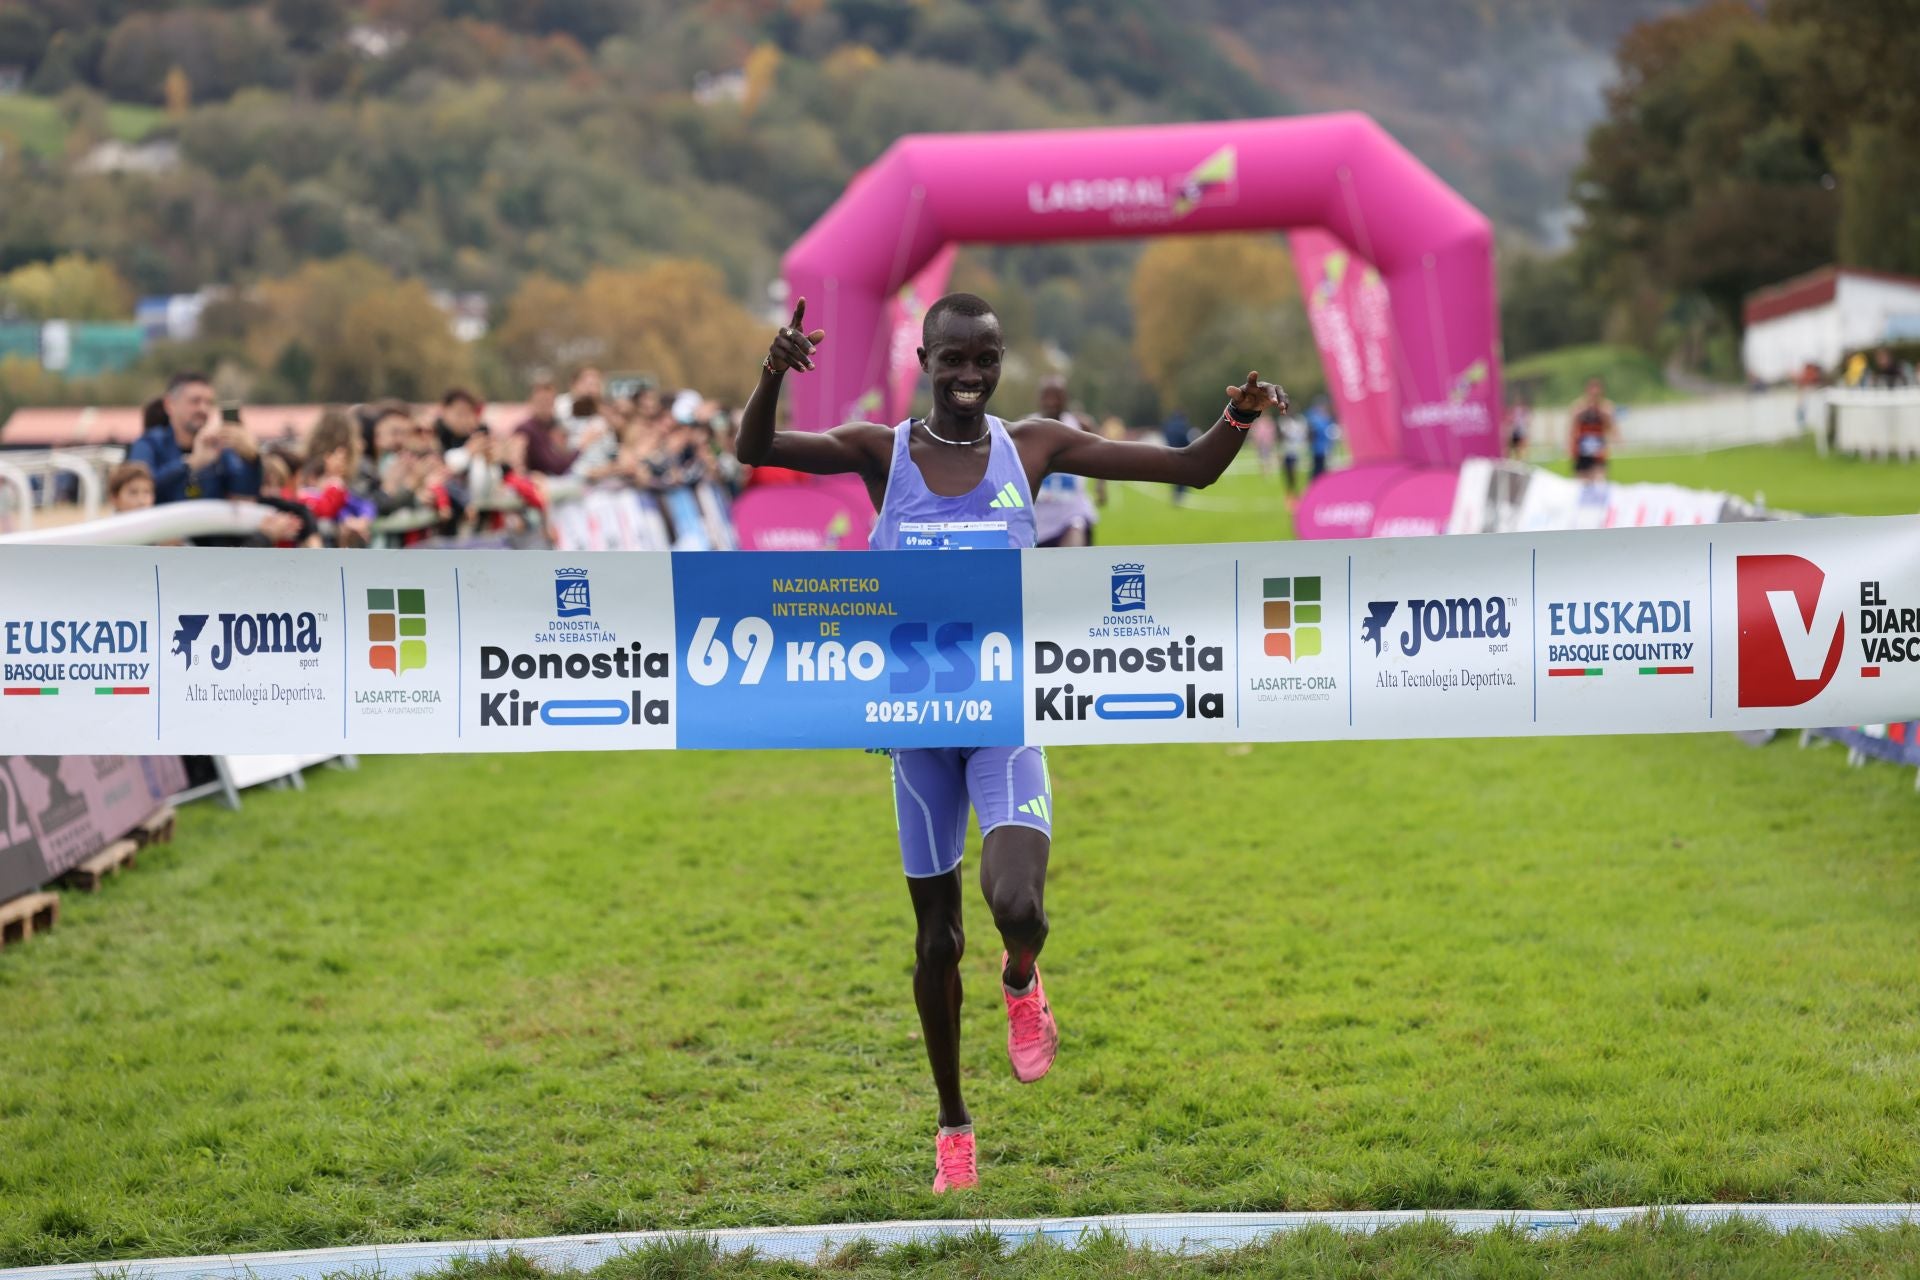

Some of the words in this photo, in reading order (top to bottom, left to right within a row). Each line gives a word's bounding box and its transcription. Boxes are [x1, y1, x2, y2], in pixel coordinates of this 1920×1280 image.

[772, 578, 879, 593] NAZIOARTEKO
[1860, 581, 1887, 606] EL
[772, 602, 898, 617] INTERNACIONAL
[1548, 600, 1691, 635] EUSKADI
[549, 621, 600, 630] DONOSTIA
[820, 622, 840, 637] DE
[1103, 615, 1154, 625] DONOSTIA
[1400, 596, 1511, 657] Joma
[4, 621, 148, 654] EUSKADI
[211, 612, 322, 671] Joma
[535, 634, 556, 642] SAN
[559, 631, 616, 642] SEBASTIÁN
[1089, 628, 1110, 637] SAN
[1113, 626, 1170, 637] SEBASTIÁN
[686, 616, 774, 686] 69
[786, 622, 1013, 694] KROSSA
[1035, 635, 1223, 674] Donostia
[1488, 643, 1508, 655] sport
[1549, 644, 1609, 663] BASQUE
[1613, 642, 1694, 661] COUNTRY
[299, 658, 319, 670] sport
[480, 641, 669, 680] Donostia
[4, 664, 65, 682] BASQUE
[68, 663, 150, 680] COUNTRY
[1376, 670, 1398, 688] Alta
[1401, 669, 1458, 691] Tecnología
[1461, 668, 1516, 690] Deportiva.
[1250, 676, 1337, 691] LASARTE-ORIA
[185, 684, 208, 701] Alta
[271, 683, 326, 705] Deportiva.
[355, 690, 441, 703] LASARTE-ORIA
[1035, 683, 1224, 721] Kirola
[1284, 693, 1330, 701] AYUNTAMIENTO
[388, 706, 434, 714] AYUNTAMIENTO
[480, 689, 669, 727] Kirola
[865, 700, 993, 724] 2025/11/02
